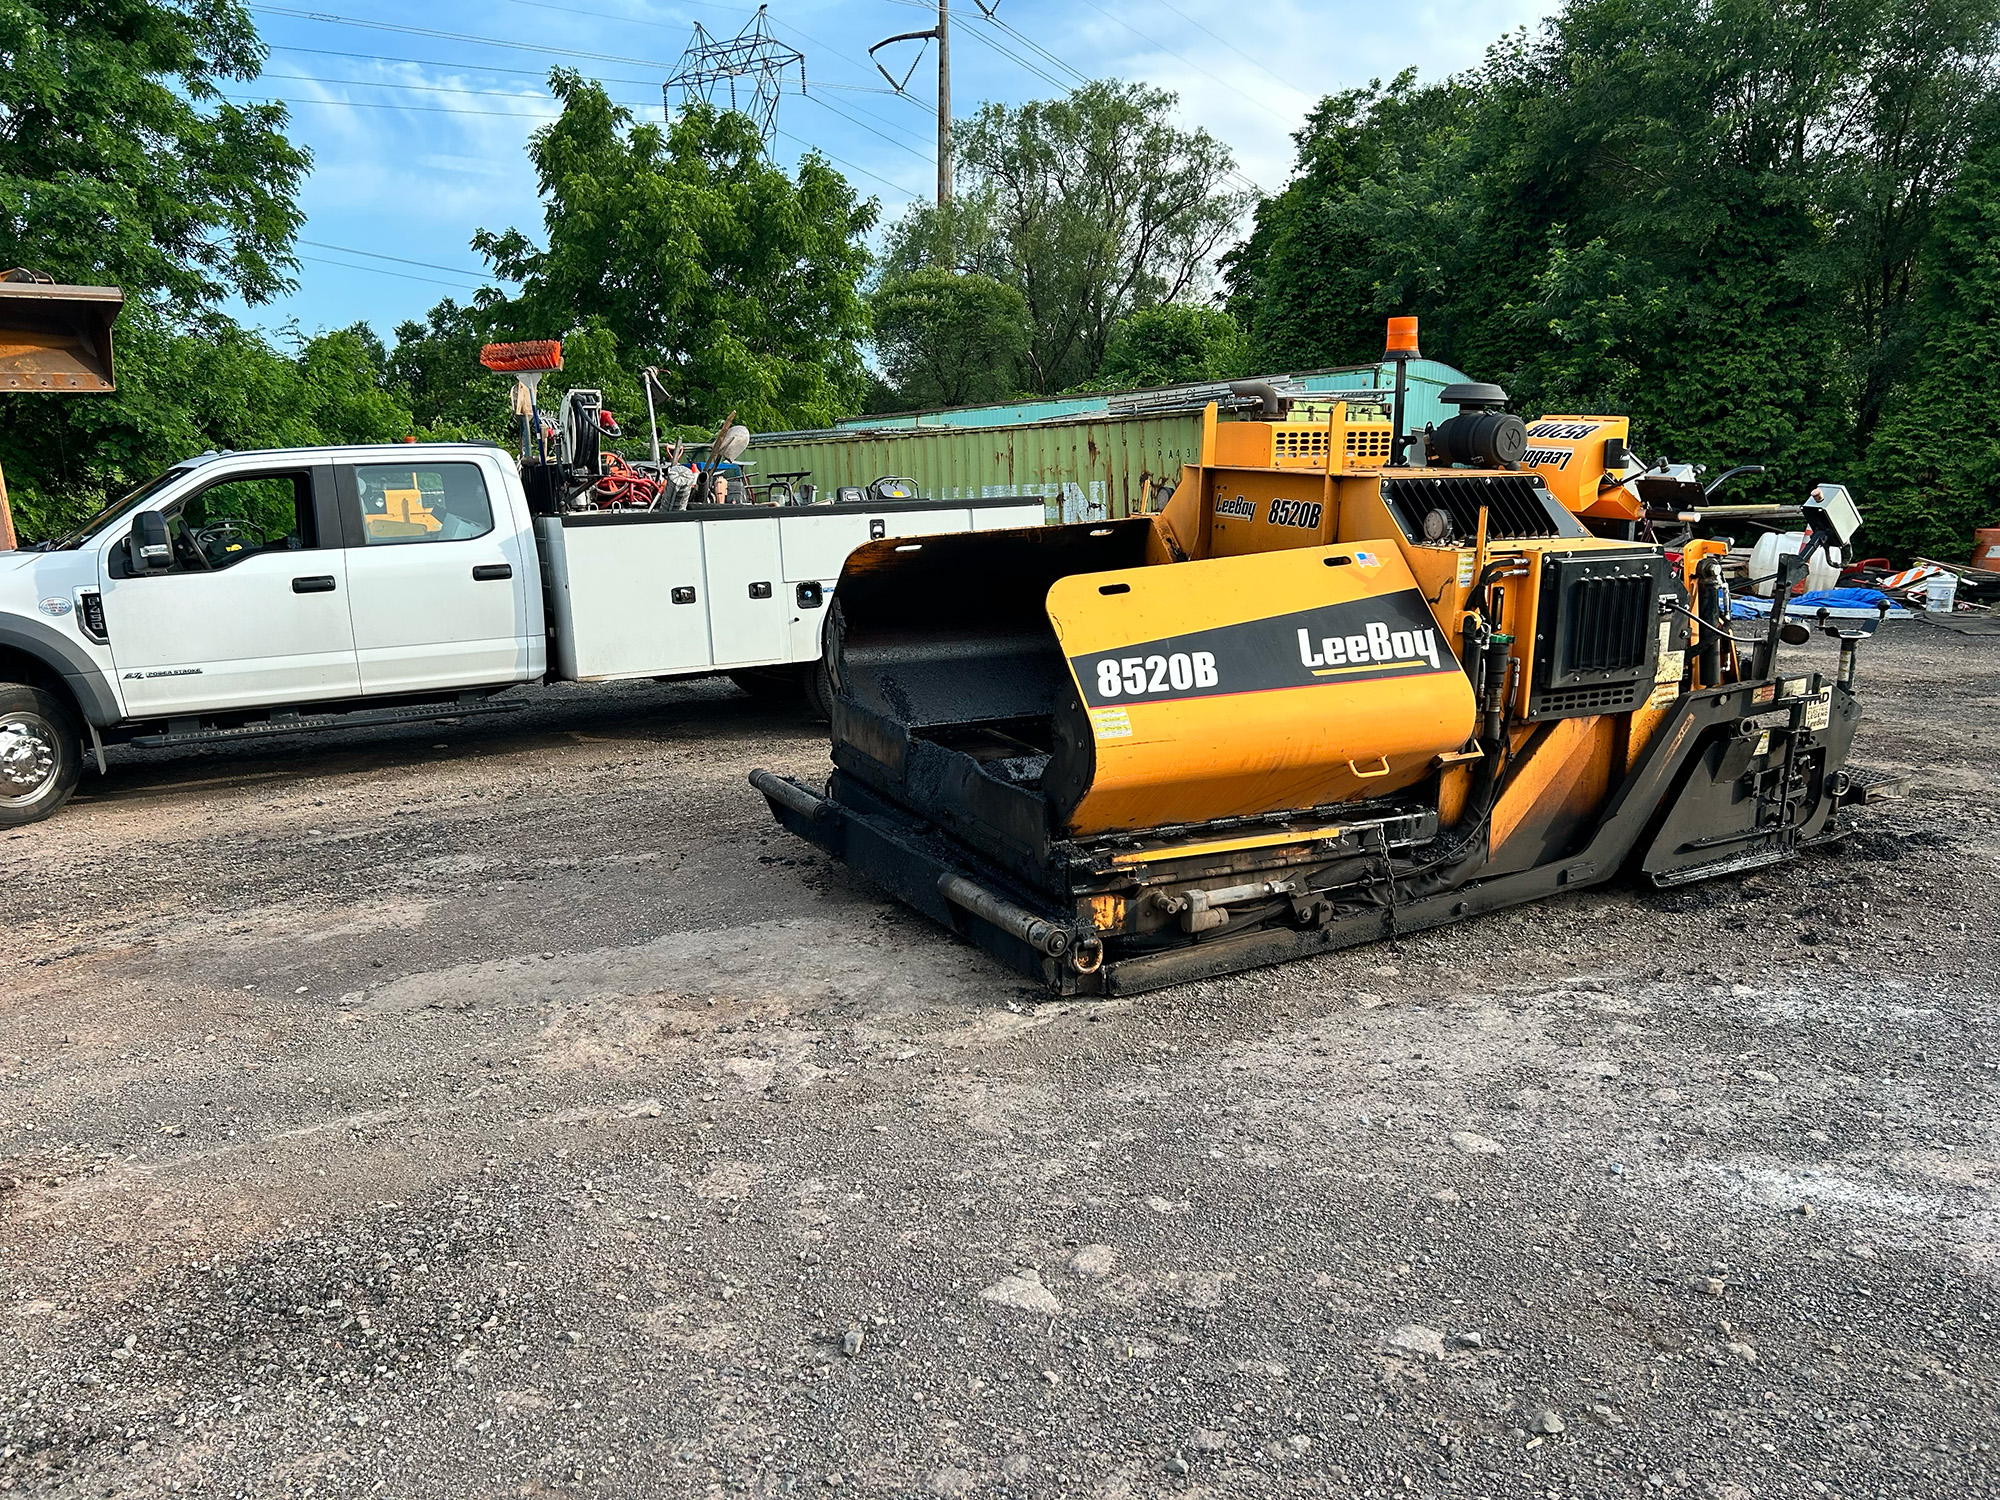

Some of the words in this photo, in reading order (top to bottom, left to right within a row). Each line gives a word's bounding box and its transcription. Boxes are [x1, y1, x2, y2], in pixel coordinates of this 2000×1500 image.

[1521, 449, 1574, 471] LeeBo
[1214, 492, 1257, 522] LeeBoy
[1267, 498, 1322, 530] 8520B
[1096, 651, 1220, 698] 8520B
[1297, 621, 1442, 669] LeeBoy
